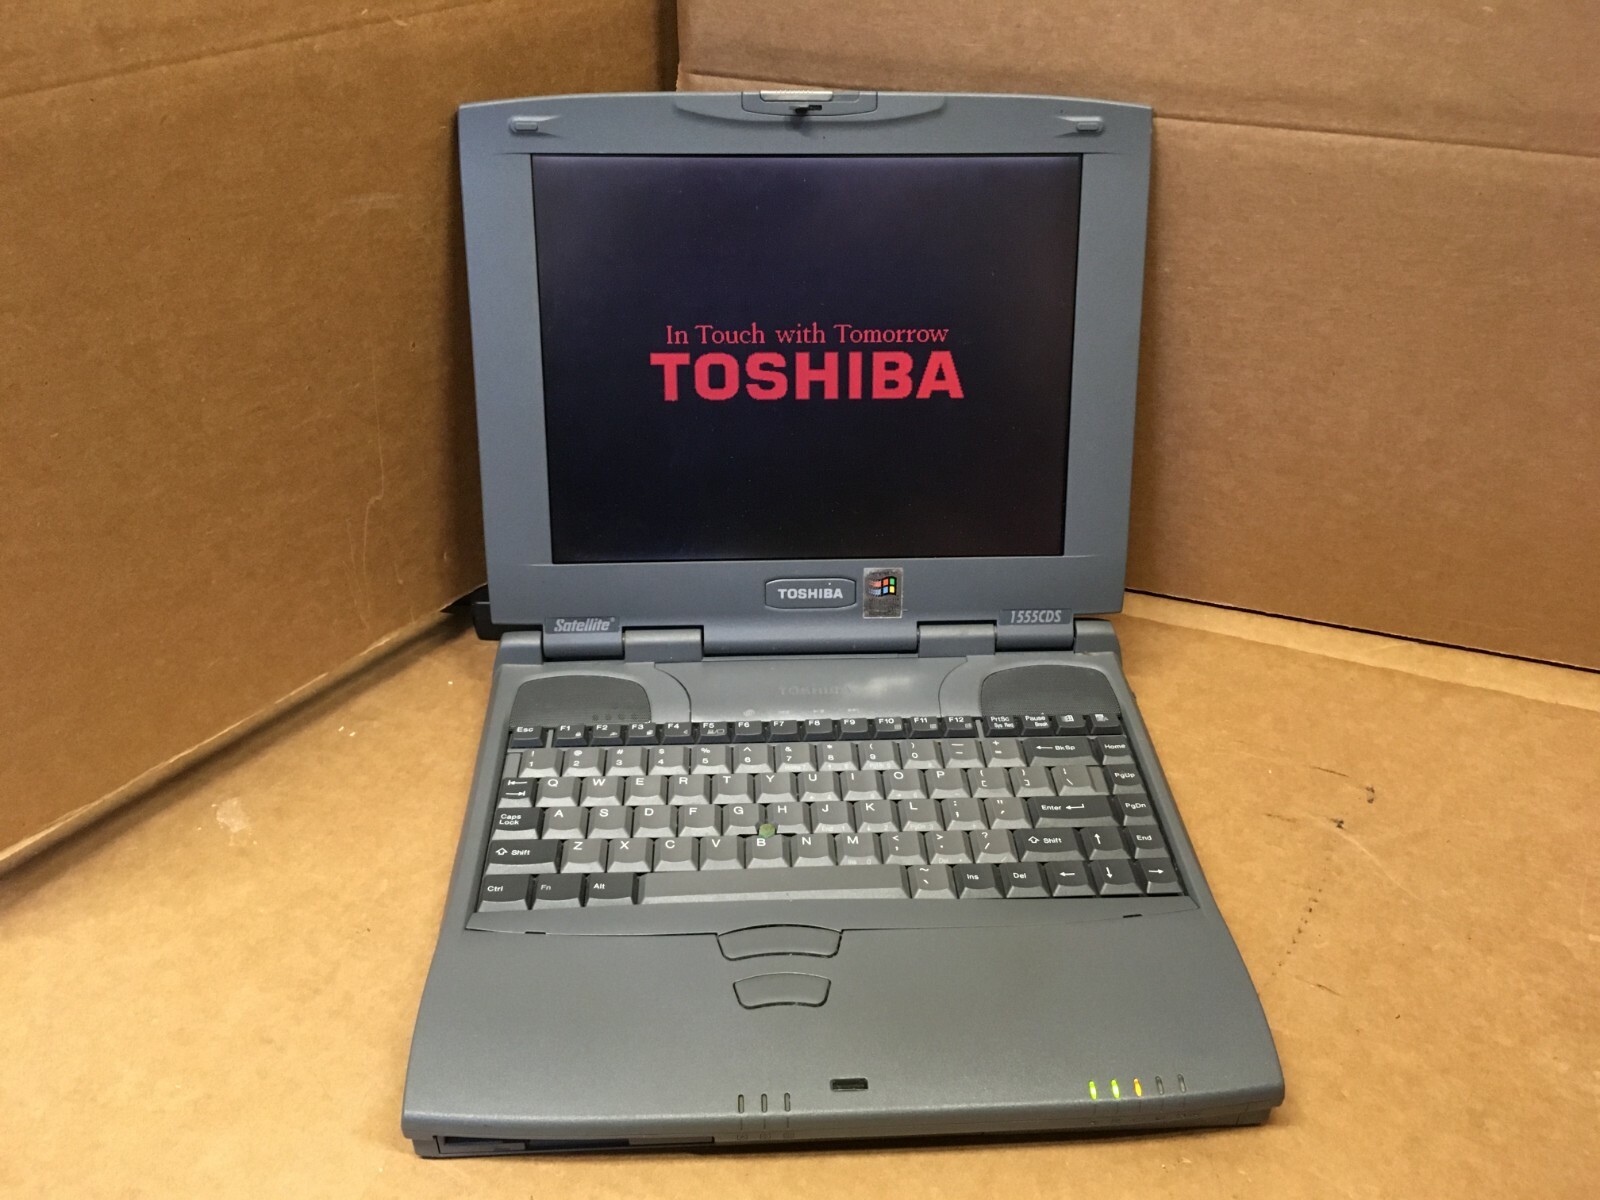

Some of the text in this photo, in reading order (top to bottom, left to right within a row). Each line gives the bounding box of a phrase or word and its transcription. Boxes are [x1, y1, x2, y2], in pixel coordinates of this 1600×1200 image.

[666, 322, 949, 344] In Touch with Tomorrow
[650, 351, 965, 401] TOSHIBA
[778, 588, 843, 599] TOSHIBA
[1010, 609, 1062, 624] 1555CDS
[548, 779, 558, 787] Q
[822, 804, 828, 812] J
[866, 803, 875, 811] K
[909, 802, 918, 810] L
[600, 809, 608, 817] S
[645, 808, 654, 816] D
[665, 840, 675, 848] C
[712, 839, 720, 847] V
[757, 838, 766, 846] B
[802, 837, 811, 845] N
[847, 836, 858, 844] M
[573, 842, 583, 850] Z
[620, 841, 629, 849] X
